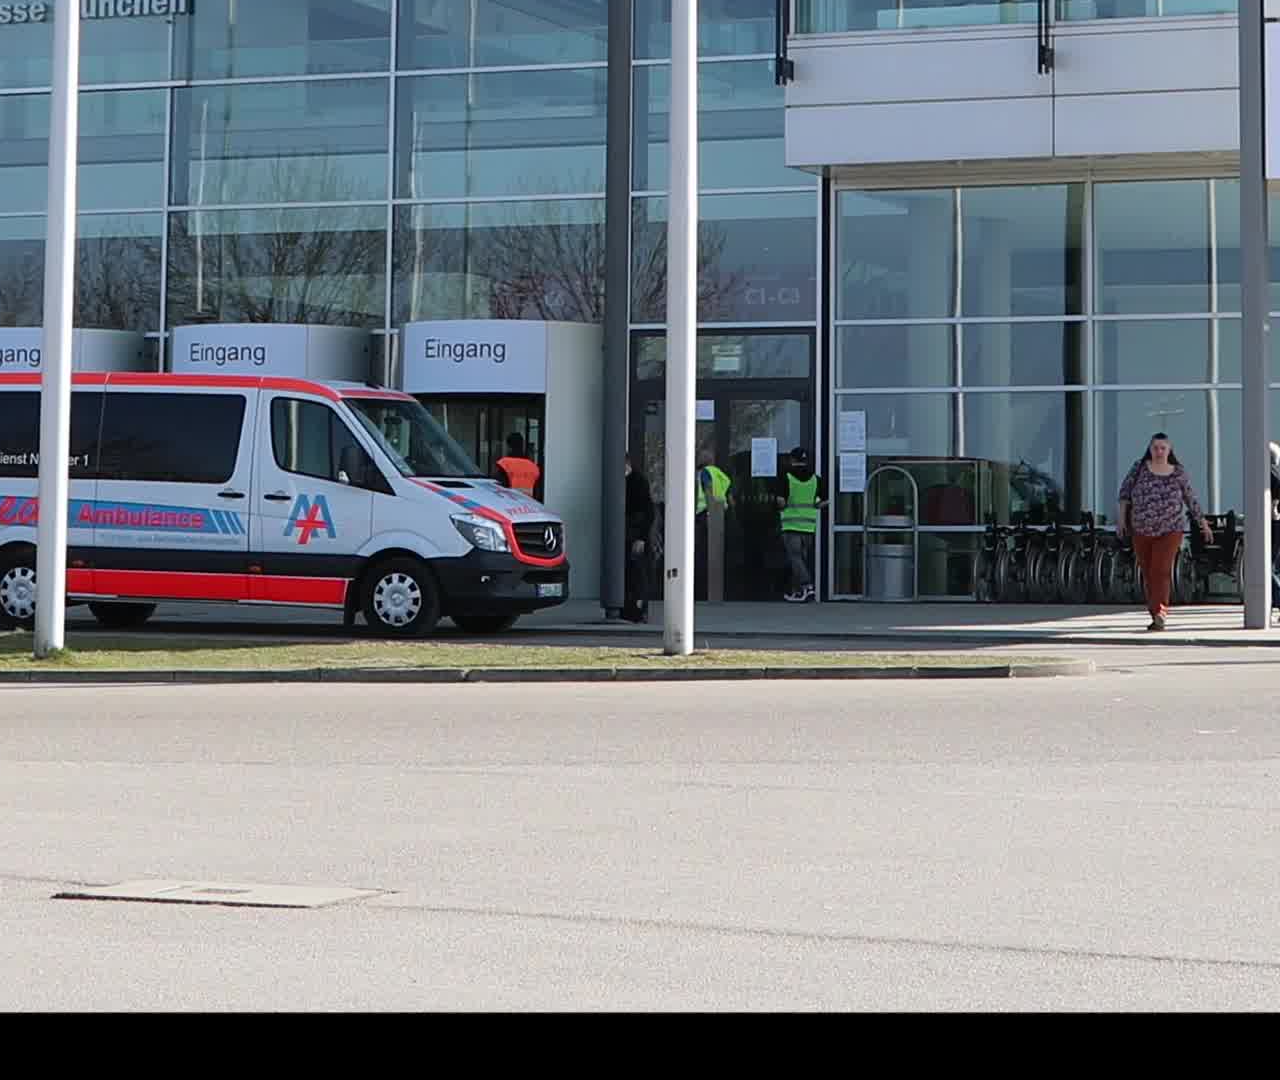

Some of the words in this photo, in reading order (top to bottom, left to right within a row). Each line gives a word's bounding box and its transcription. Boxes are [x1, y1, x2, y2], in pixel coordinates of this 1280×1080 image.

[190, 343, 266, 365] Eingang
[425, 339, 506, 363] Eingang
[83, 454, 90, 467] 1
[78, 503, 204, 529] Ambulance
